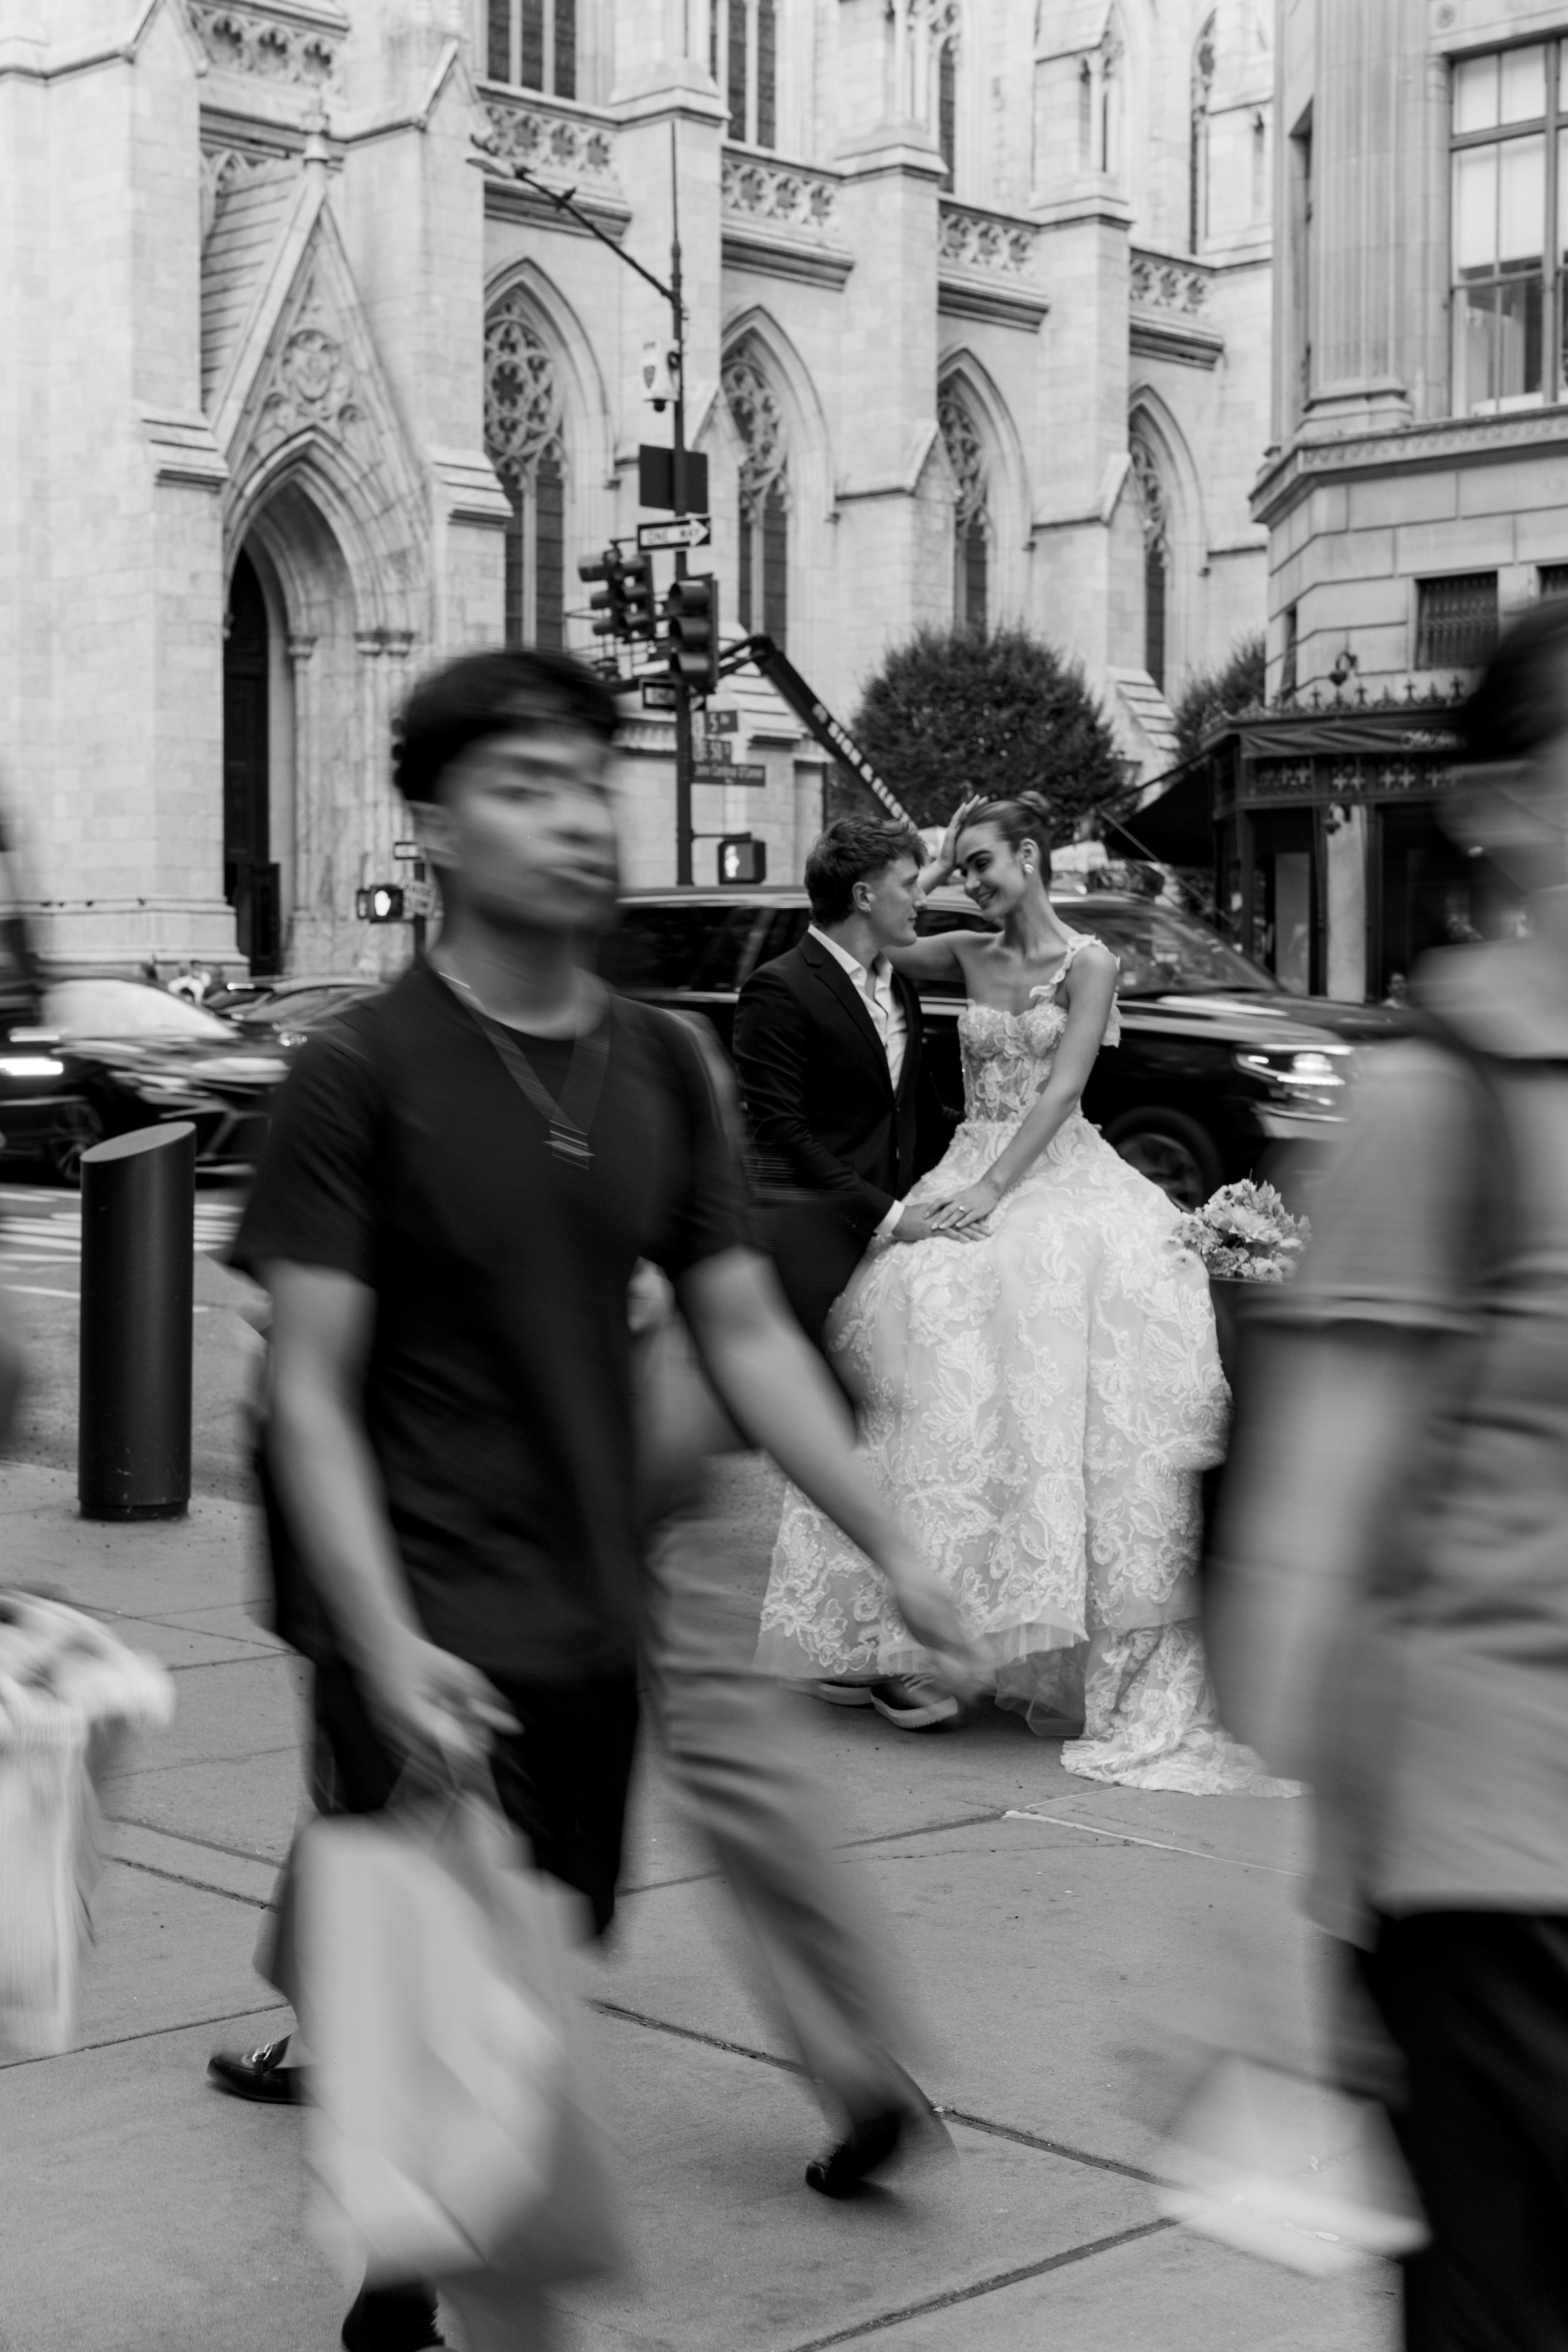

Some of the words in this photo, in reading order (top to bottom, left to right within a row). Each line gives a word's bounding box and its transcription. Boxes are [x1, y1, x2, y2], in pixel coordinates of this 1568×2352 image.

[647, 528, 669, 545] ONE
[679, 527, 699, 540] WAY
[709, 712, 718, 733] 5
